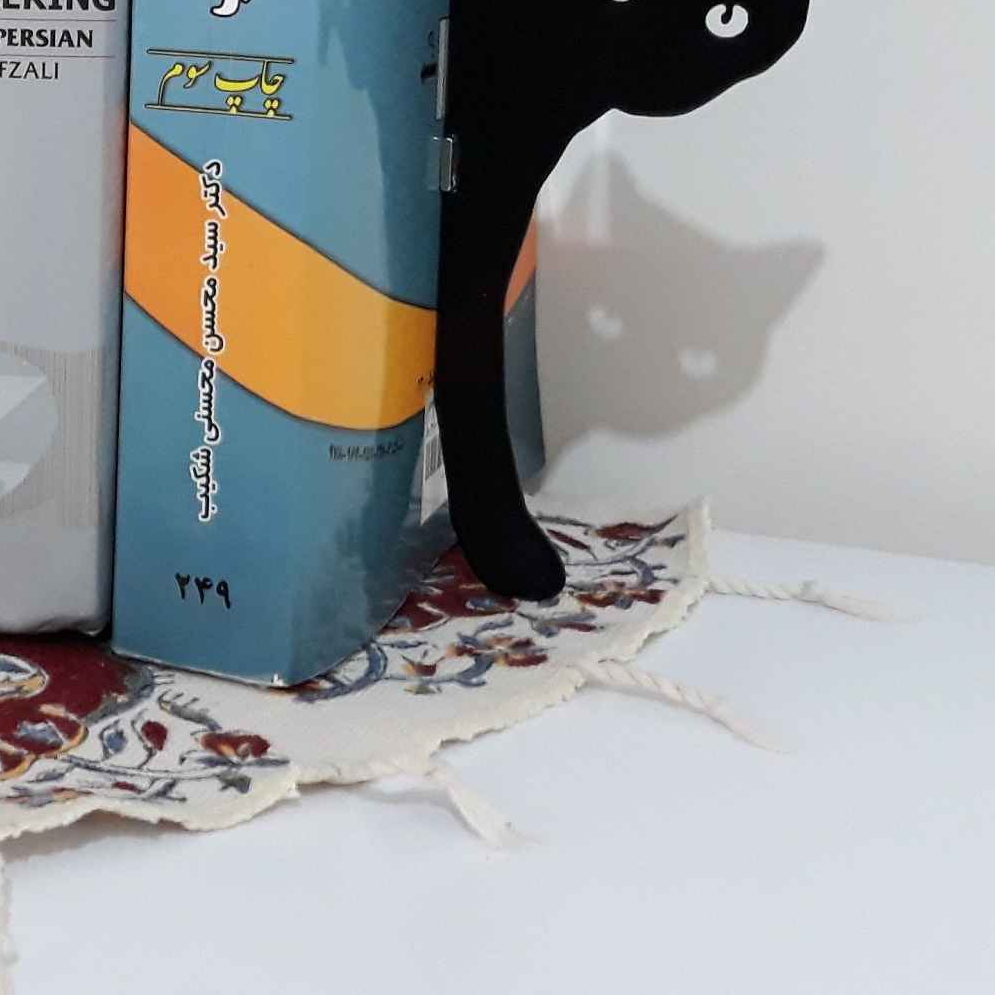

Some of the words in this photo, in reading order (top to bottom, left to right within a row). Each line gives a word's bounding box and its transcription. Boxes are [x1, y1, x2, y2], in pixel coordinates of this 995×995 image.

[158, 60, 213, 107] سوم
[214, 60, 287, 118] چاپ
[197, 160, 227, 218] دکتر
[198, 221, 227, 272] سید
[197, 277, 225, 354] محسن
[192, 358, 222, 444] محسنی
[189, 446, 219, 524] شکیب
[174, 572, 231, 609] ۲۴۹
